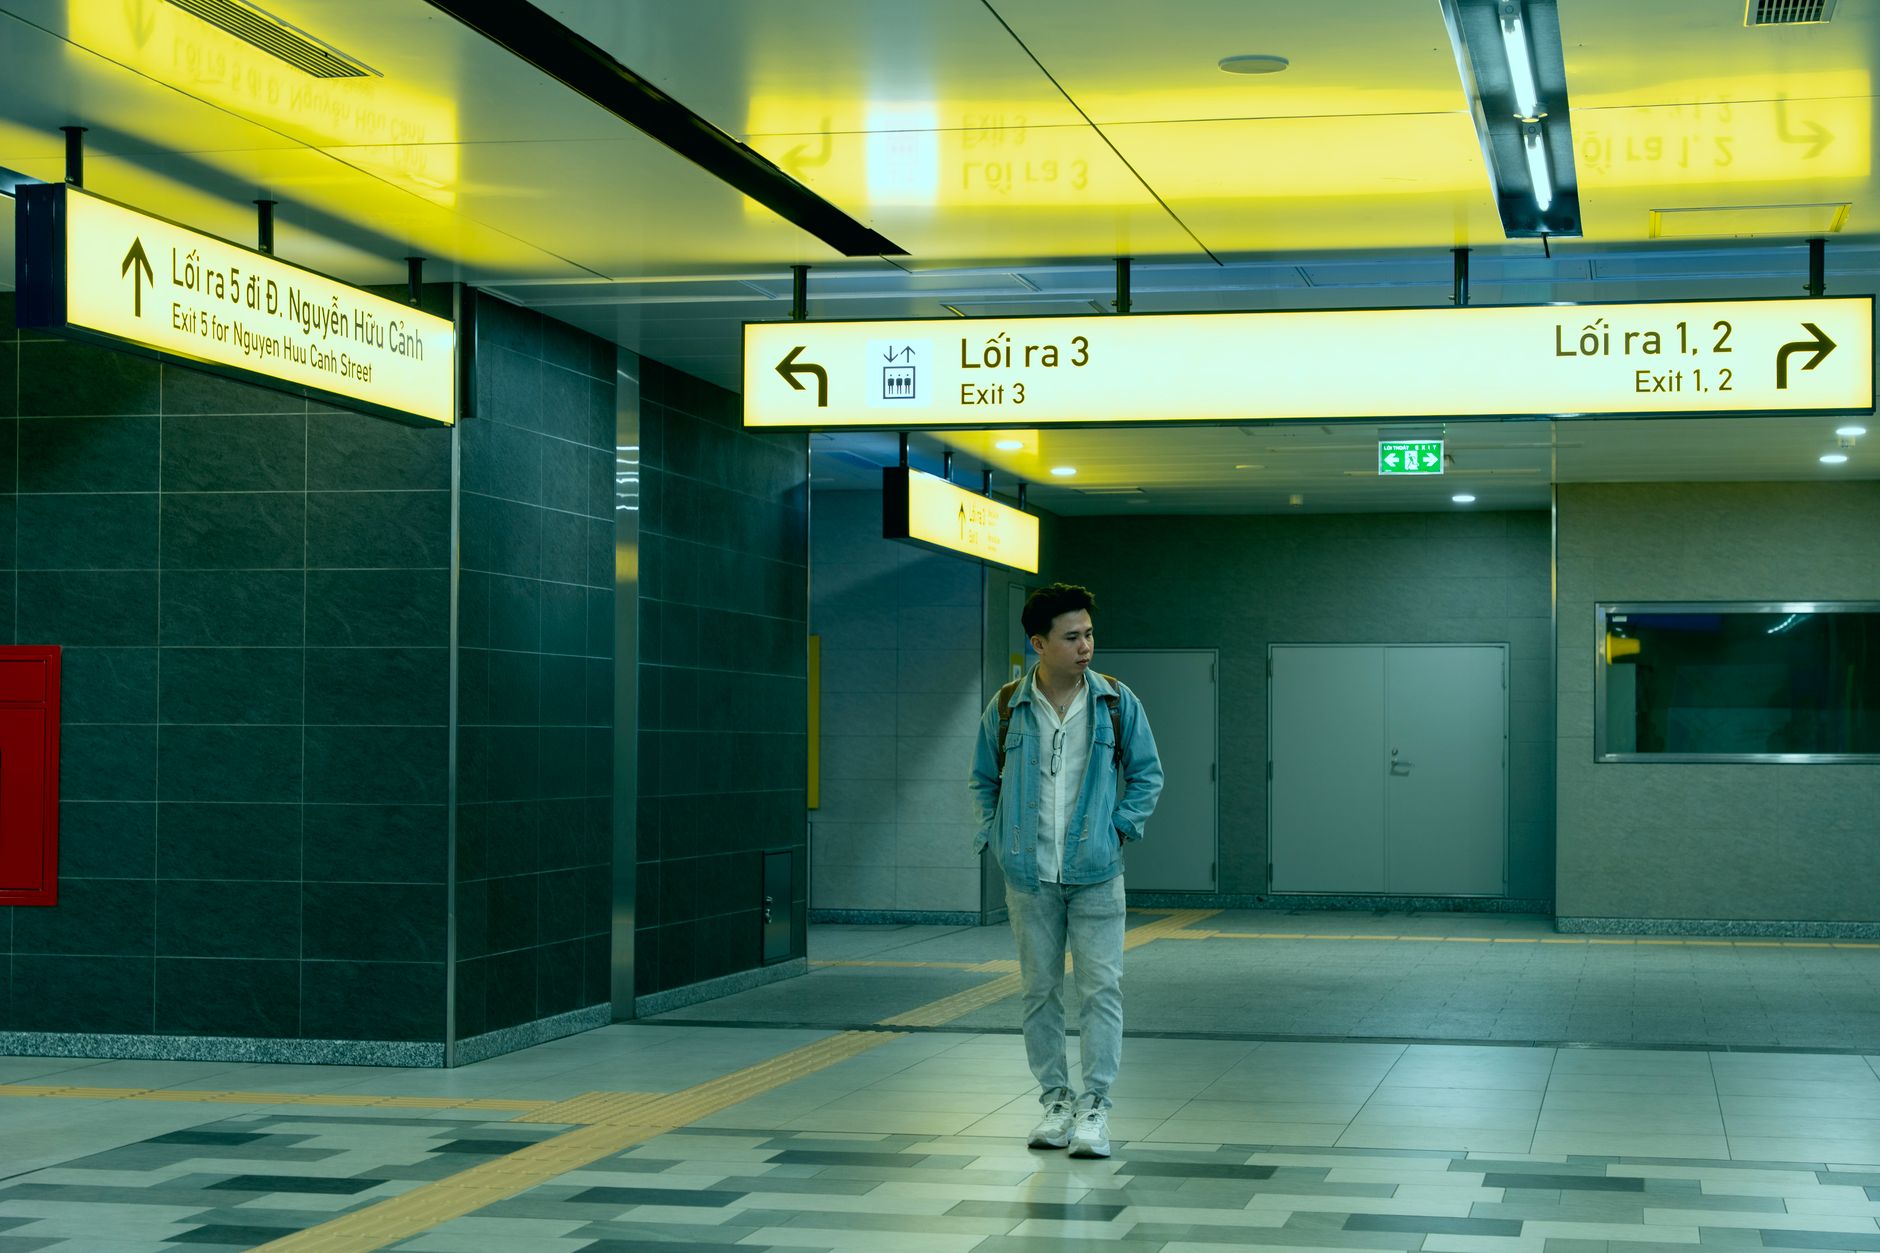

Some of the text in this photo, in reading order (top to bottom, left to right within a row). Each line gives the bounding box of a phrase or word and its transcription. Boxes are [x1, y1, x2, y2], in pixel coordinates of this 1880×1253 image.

[172, 247, 424, 361] Lối ra 5 đi Đ. Nguyễn Hữu Cảnh
[172, 302, 373, 384] Exit 5 for Nguyen Huu Canh Street
[960, 331, 1090, 369] Lối ra 3
[1555, 317, 1733, 357] Lối ra 1, 2
[960, 382, 1026, 406] Exit 3
[1634, 368, 1733, 394] Exit 1, 2
